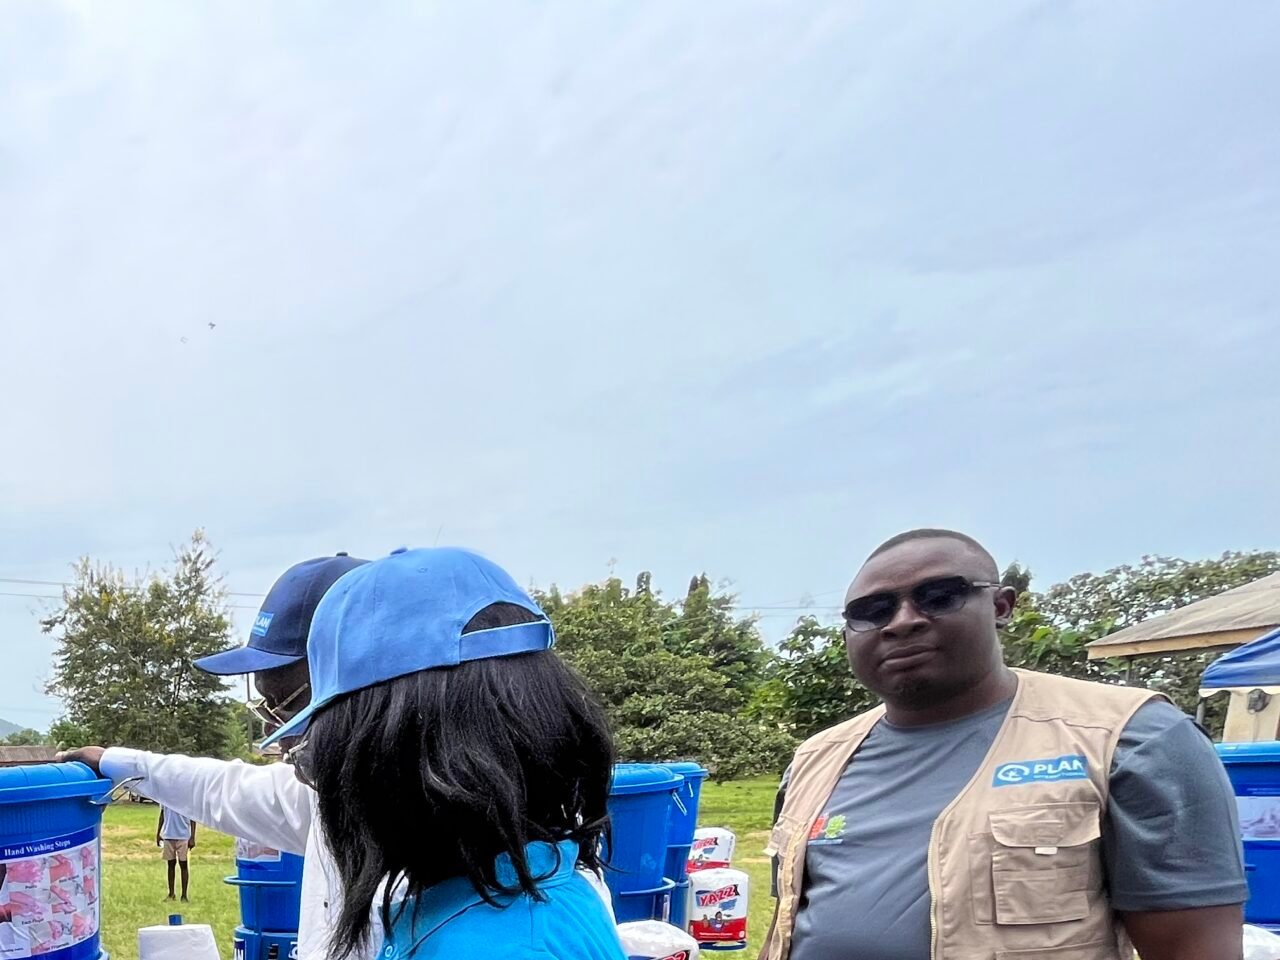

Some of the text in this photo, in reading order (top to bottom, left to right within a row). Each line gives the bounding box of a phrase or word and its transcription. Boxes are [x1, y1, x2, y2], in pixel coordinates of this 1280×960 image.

[4, 846, 25, 856] Hand
[25, 842, 55, 853] Washing
[699, 884, 736, 906] YAZZ
